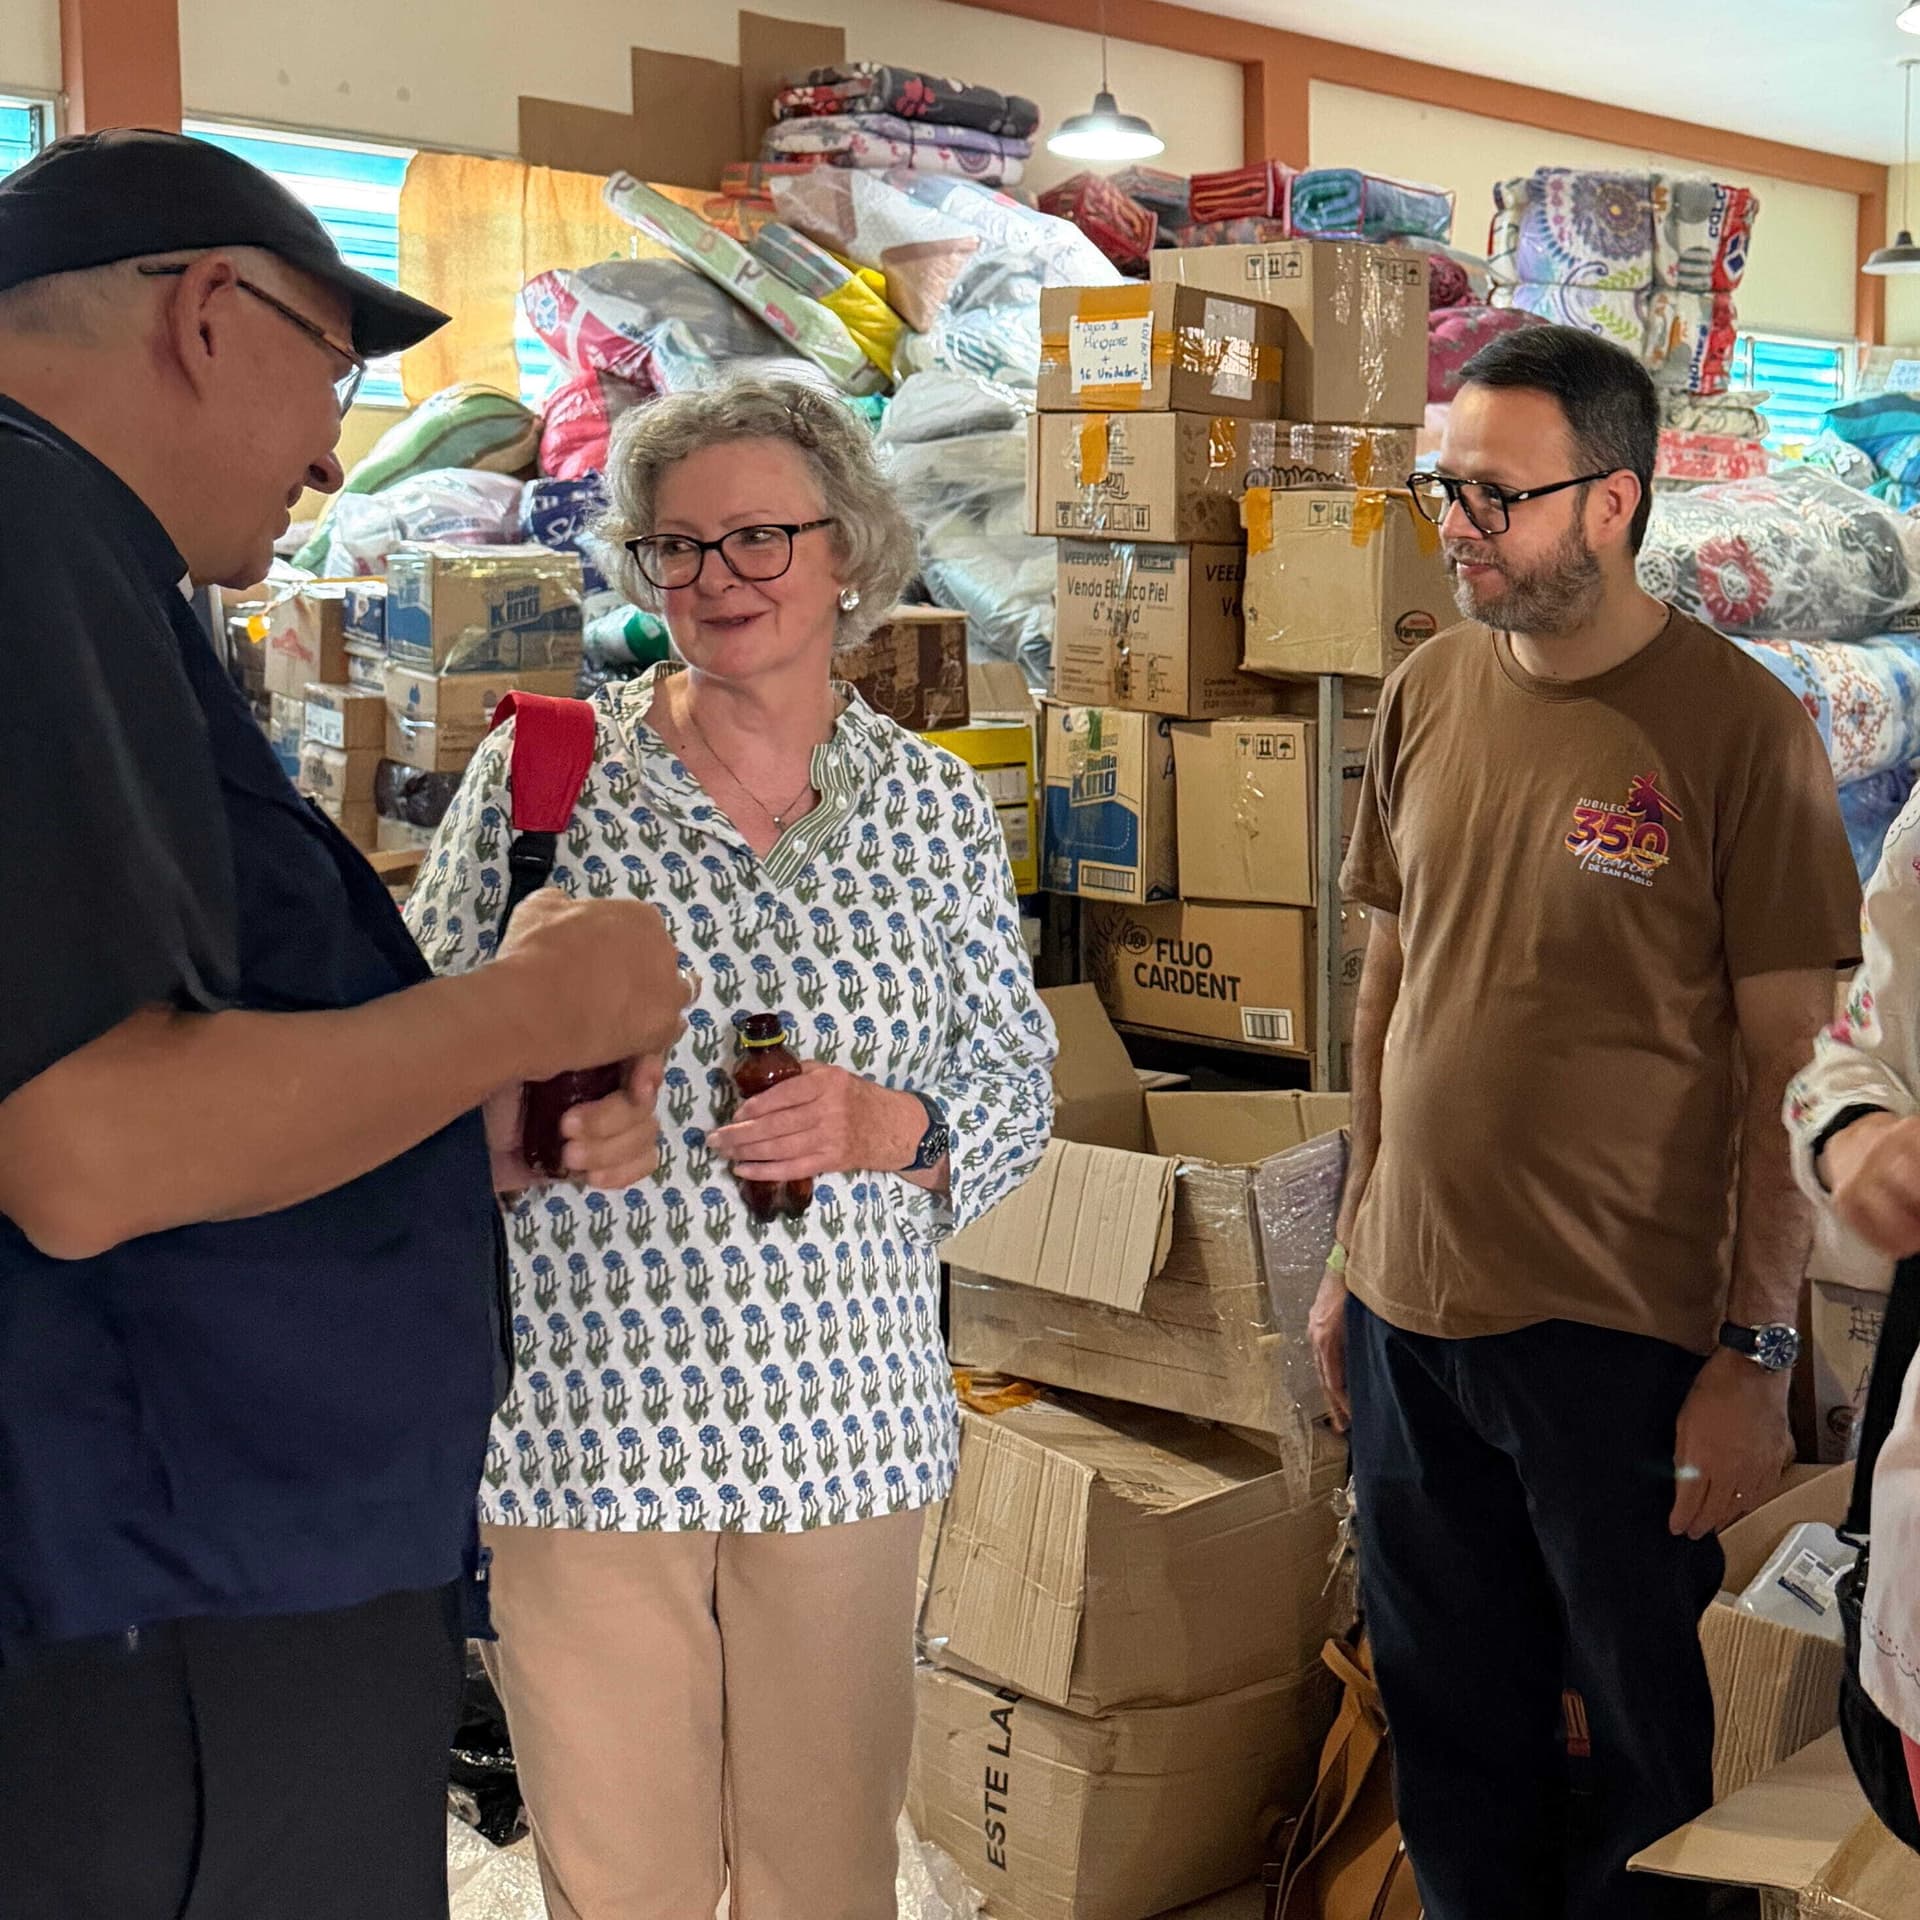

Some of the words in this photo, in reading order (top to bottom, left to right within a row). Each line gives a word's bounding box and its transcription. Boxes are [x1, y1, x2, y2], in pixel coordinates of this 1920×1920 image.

[1067, 575, 1102, 597] Venda
[1148, 581, 1168, 603] Piel
[1577, 797, 1626, 814] JUBILEO
[1565, 806, 1669, 868] 350
[1588, 863, 1600, 872] DE
[1601, 866, 1621, 878] SAN
[1623, 871, 1653, 887] PABLO
[1155, 937, 1213, 969] FLUO
[1134, 962, 1242, 1002] CARDENT
[984, 1766, 1009, 1871] ESTE
